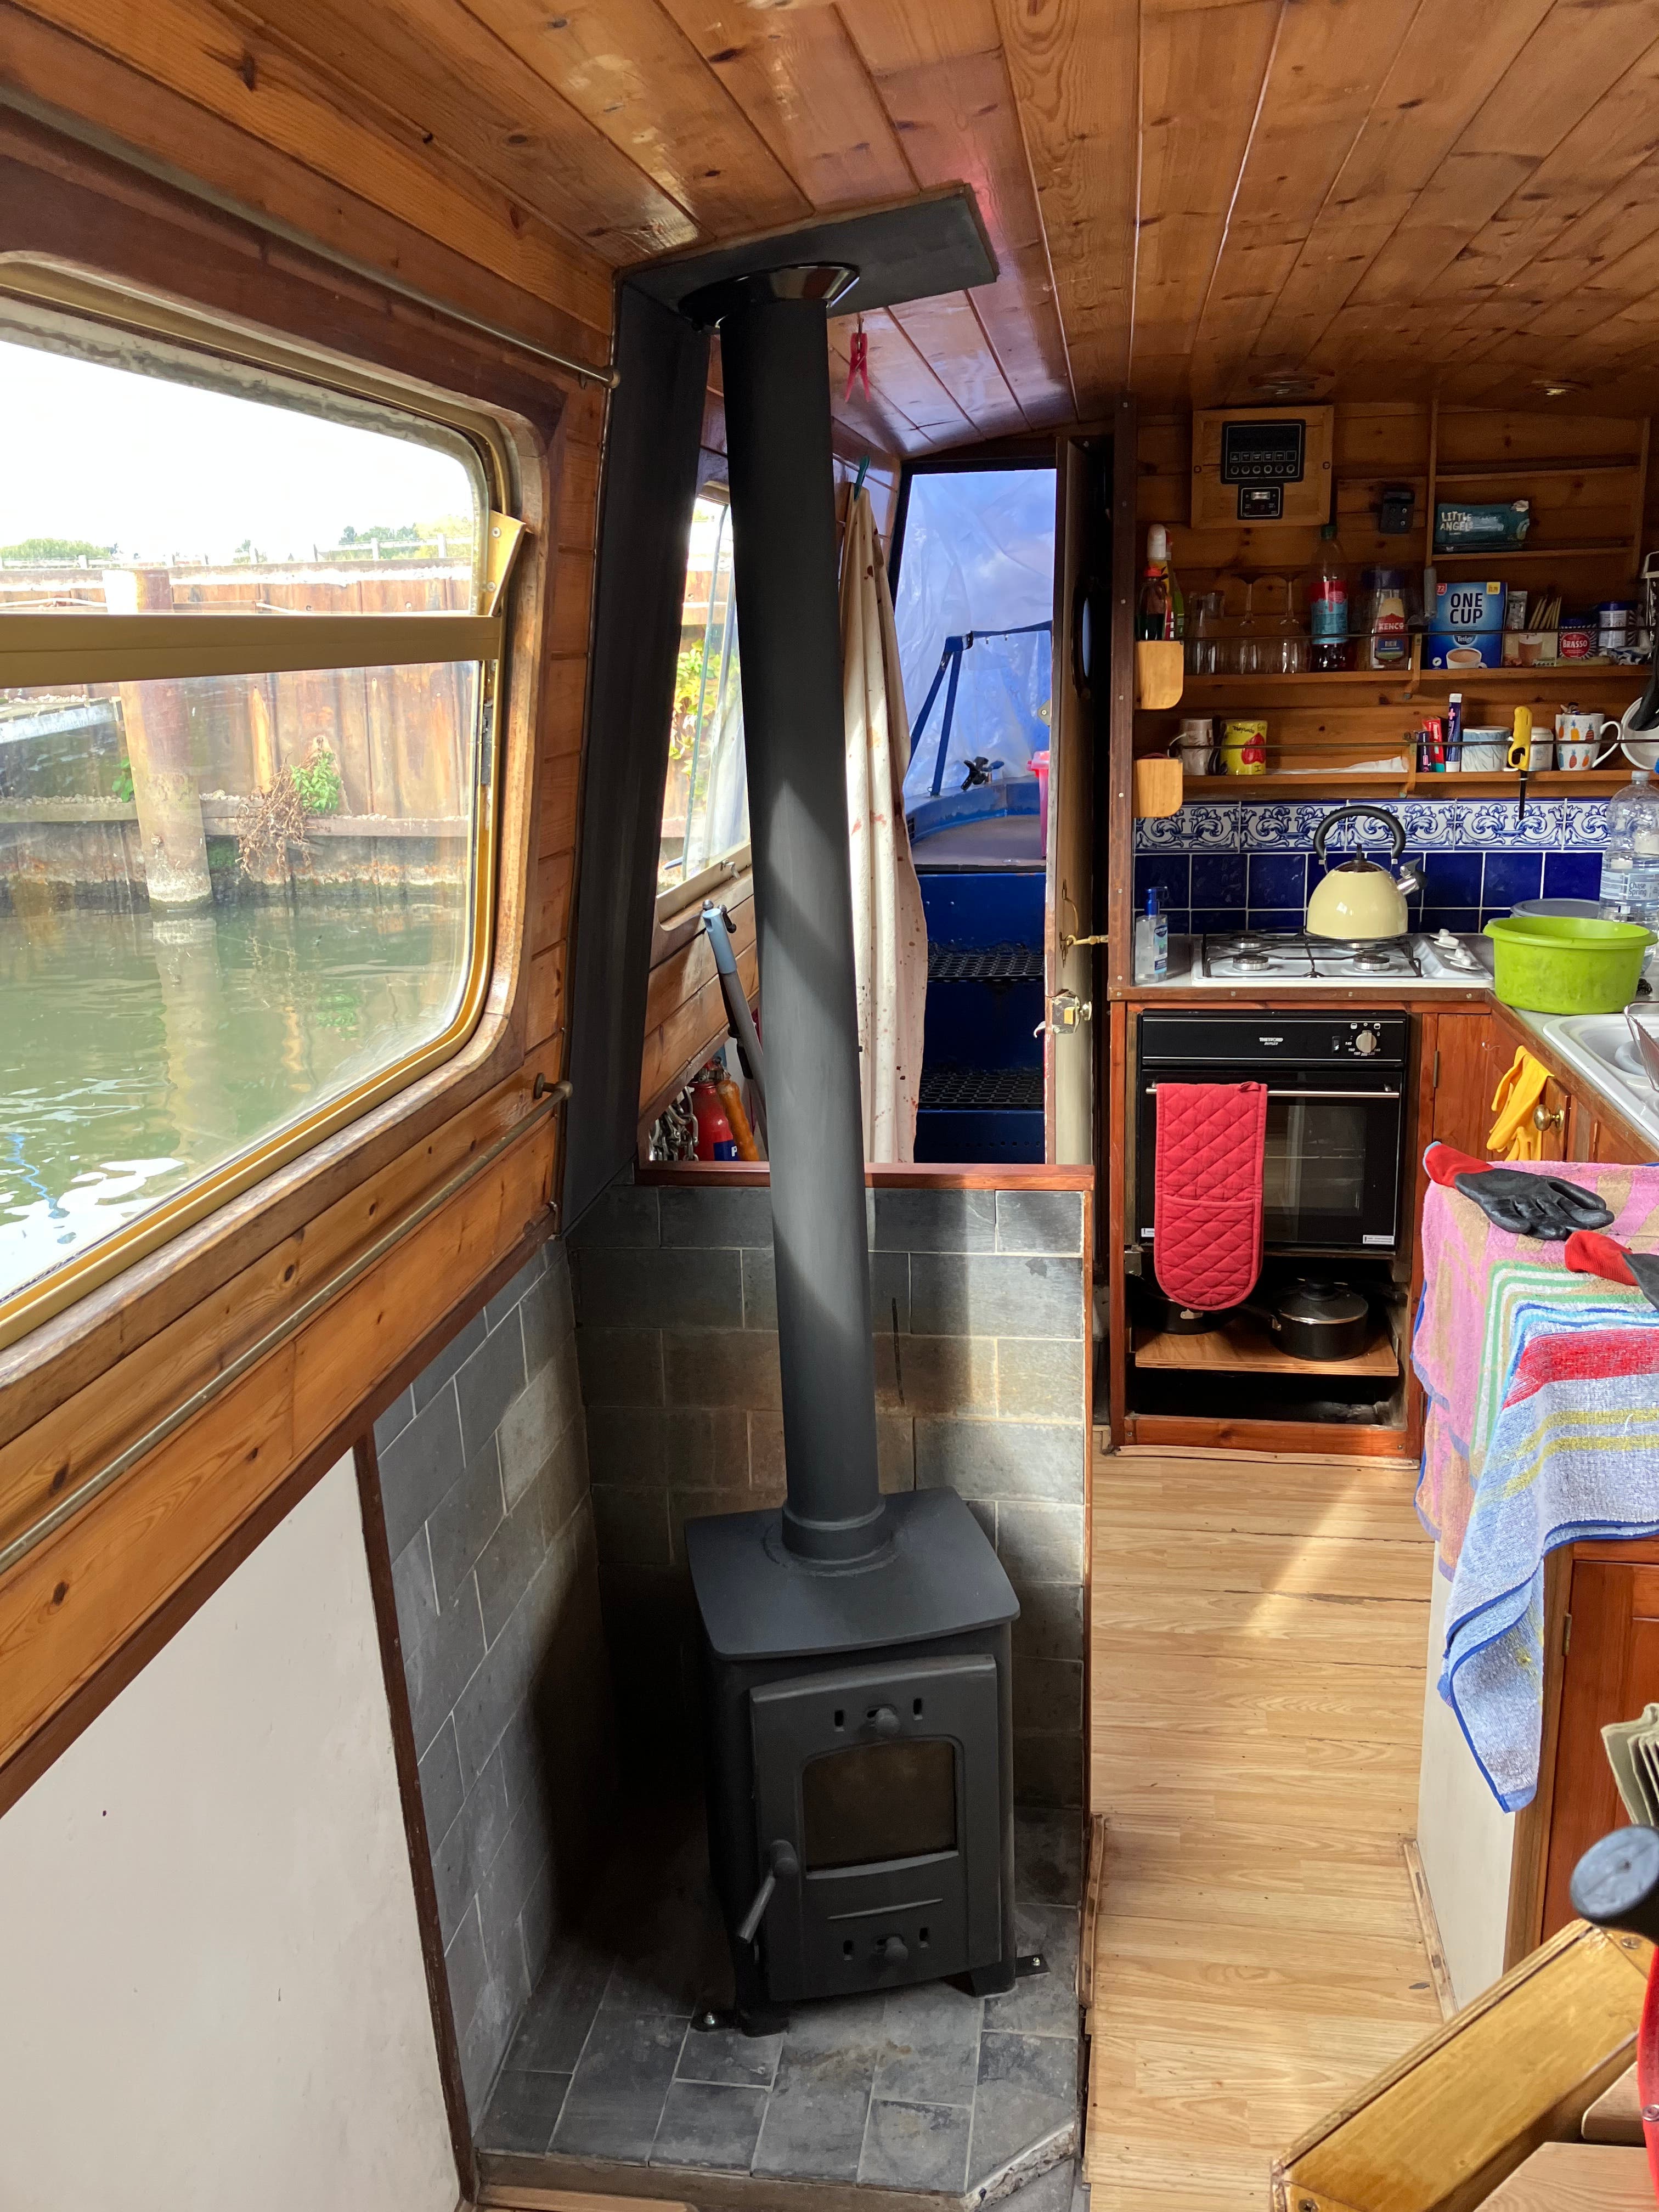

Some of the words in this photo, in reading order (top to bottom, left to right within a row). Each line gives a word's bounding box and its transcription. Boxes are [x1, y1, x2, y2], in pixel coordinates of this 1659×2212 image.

[1441, 511, 1472, 522] LITTLE
[1440, 521, 1474, 532] ANGELS
[1450, 593, 1483, 608] ONE
[1449, 608, 1483, 624] CUP
[1378, 622, 1404, 630] KENCO
[1563, 639, 1588, 648] BRASSO
